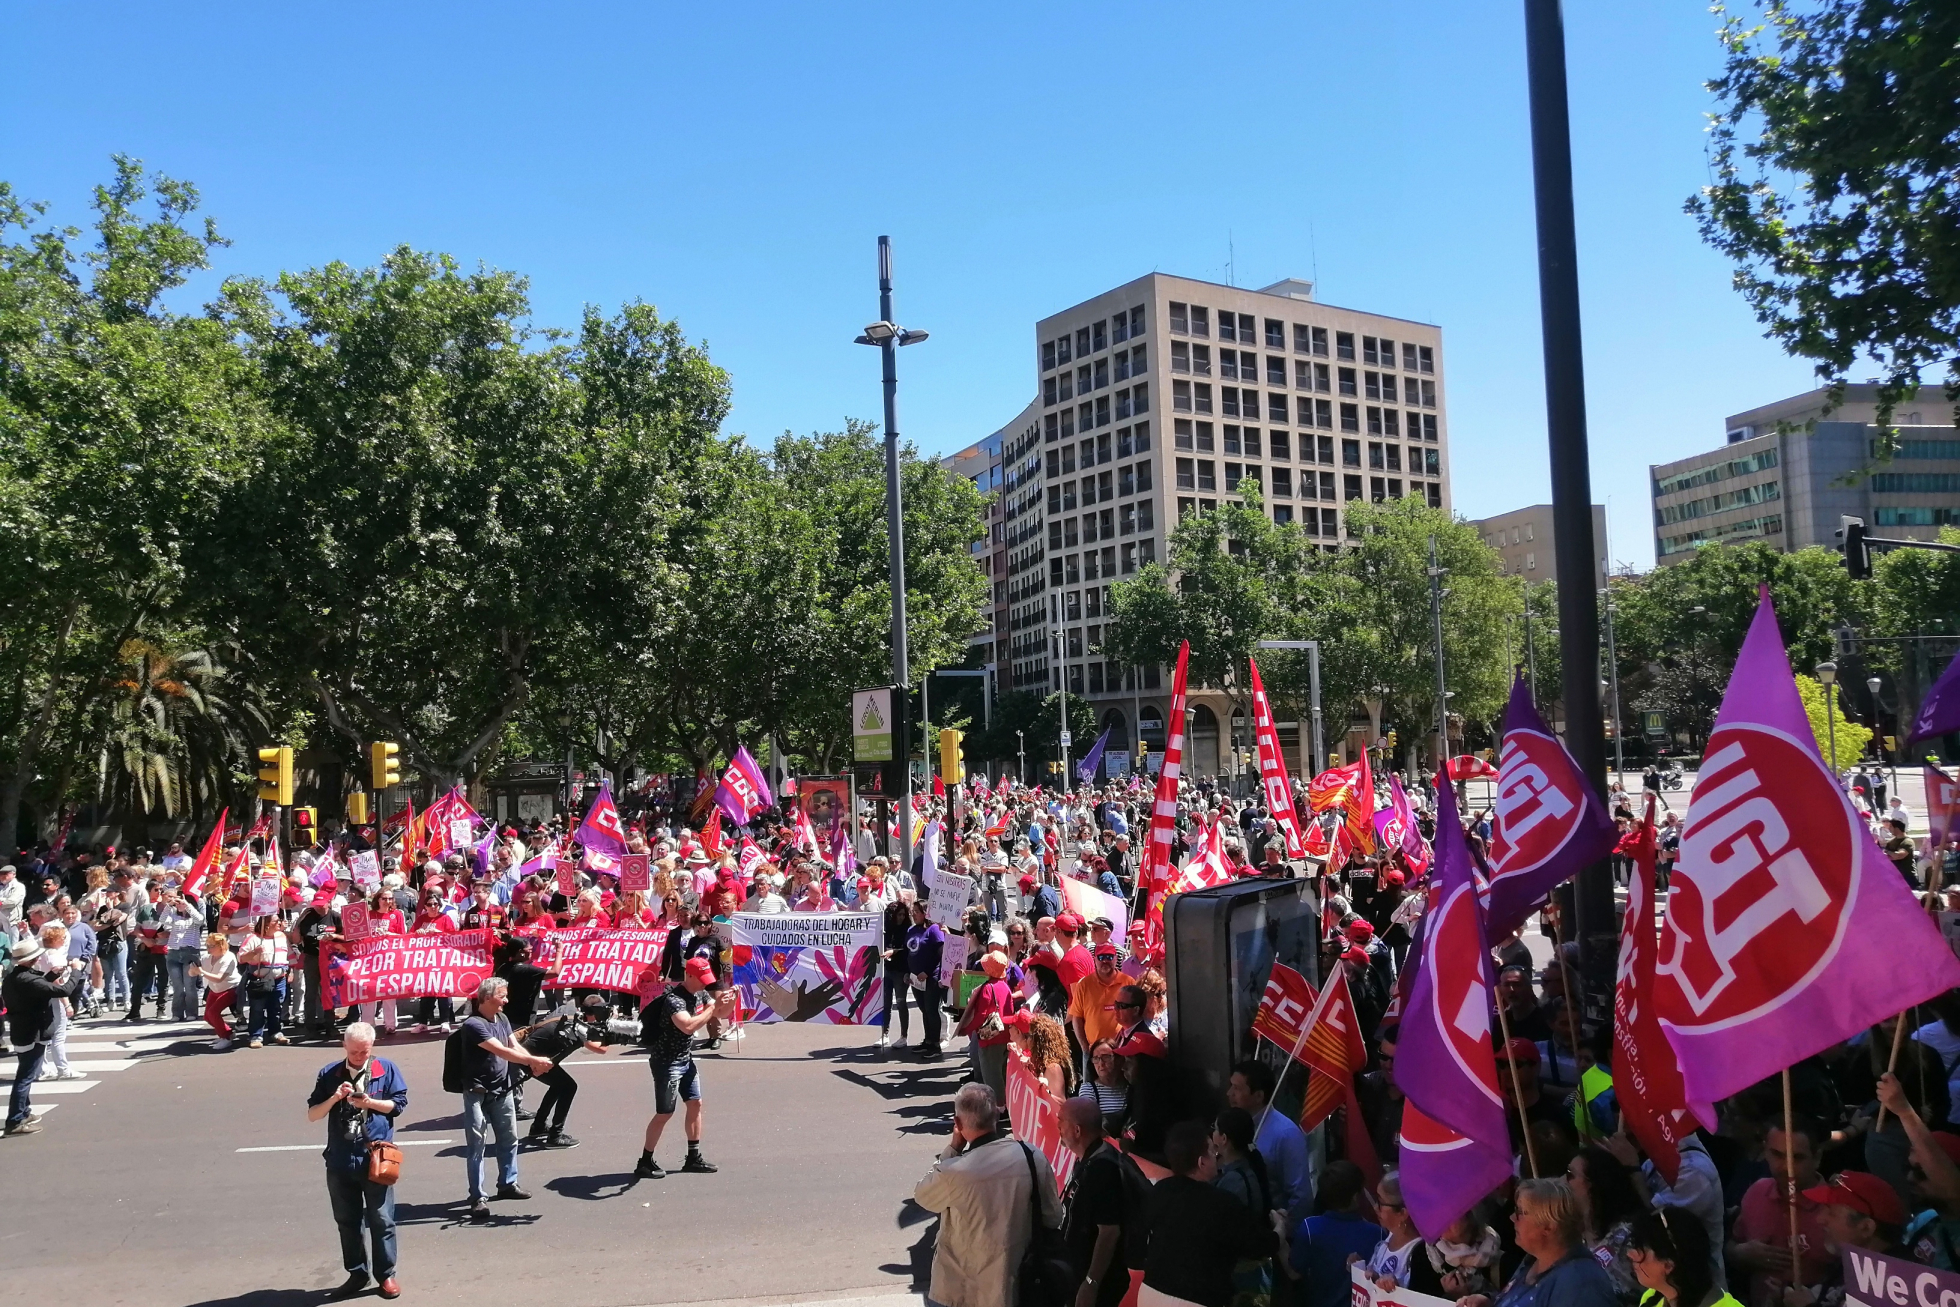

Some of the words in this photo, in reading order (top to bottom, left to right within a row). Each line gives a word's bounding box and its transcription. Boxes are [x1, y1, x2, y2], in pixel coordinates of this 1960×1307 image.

[1496, 739, 1575, 840] UGT
[1680, 740, 1833, 955] UGT
[543, 929, 580, 942] SOMOS
[581, 928, 594, 940] EL
[596, 930, 667, 943] PROFESORAD
[744, 918, 811, 931] TRABAJADORAS
[812, 918, 829, 931] DEL
[831, 918, 862, 931] HOGAR
[861, 918, 871, 930] Y
[761, 932, 805, 946] CUIDADOS
[807, 933, 819, 945] EN
[821, 933, 851, 946] LUCHA
[351, 938, 389, 956] SOMOS
[392, 938, 405, 949] EL
[408, 932, 485, 949] PROFESORADO
[348, 951, 397, 976] PEOR
[402, 948, 488, 970] TRATADO
[556, 960, 635, 990] ESPAÑA
[346, 978, 370, 1002] DE
[375, 968, 454, 998] ESPAÑA
[1850, 1251, 1909, 1305] We
